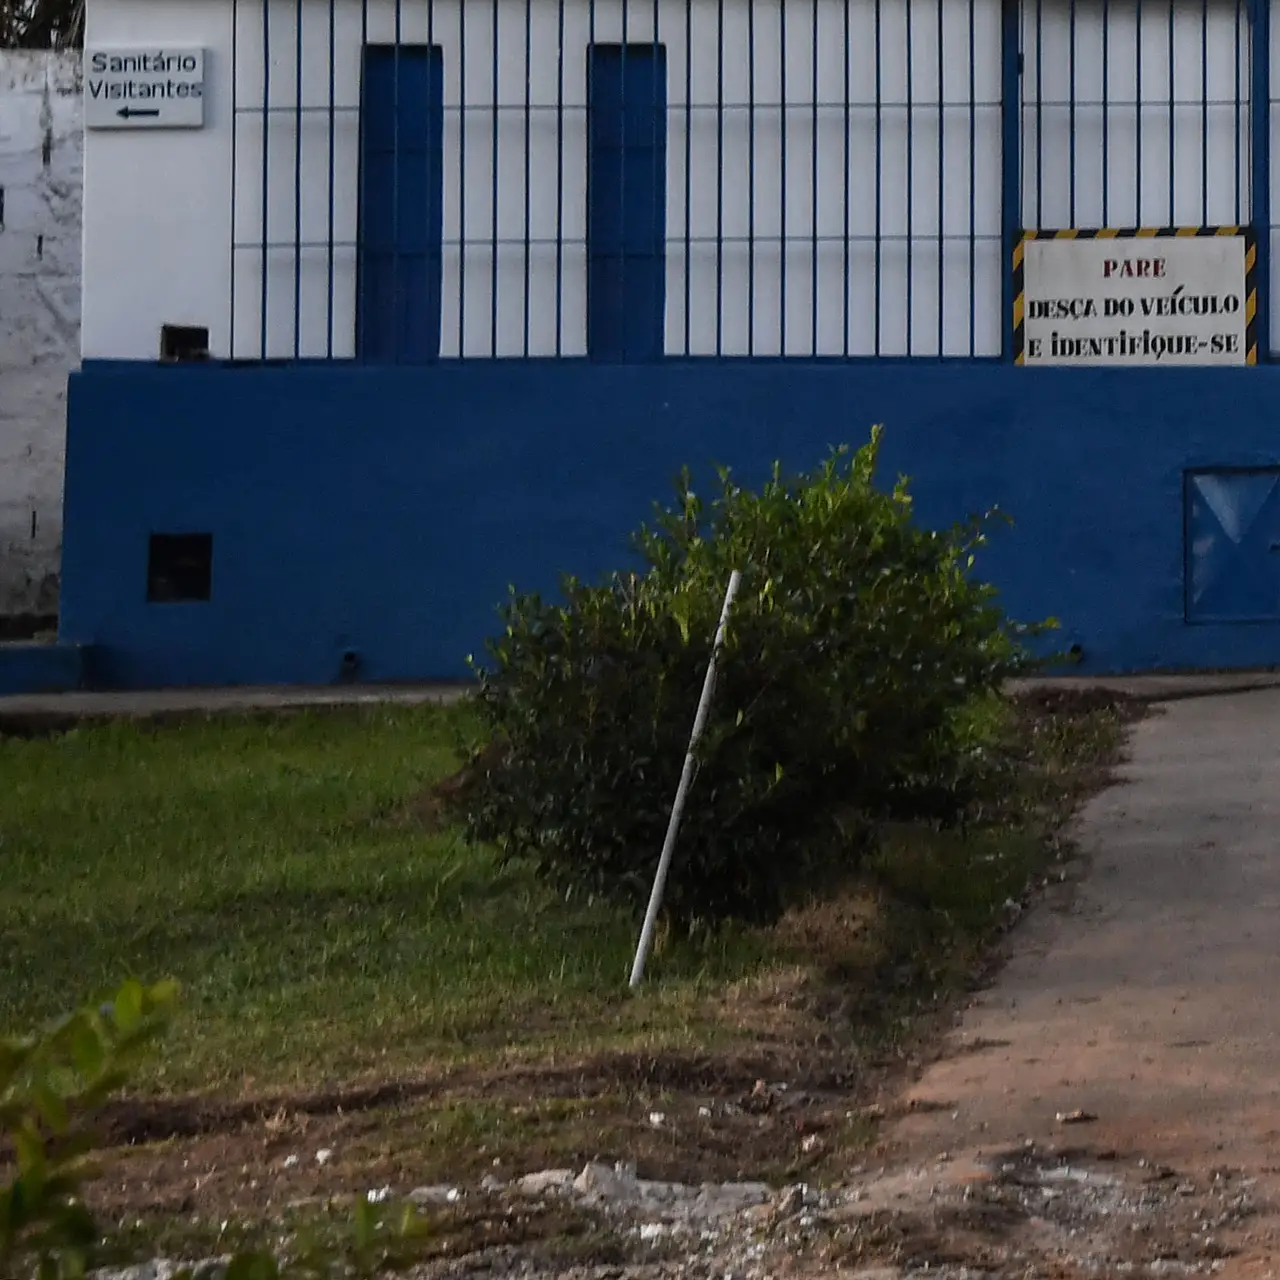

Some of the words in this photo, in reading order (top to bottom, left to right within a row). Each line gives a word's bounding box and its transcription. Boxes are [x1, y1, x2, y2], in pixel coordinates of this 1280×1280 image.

[91, 50, 196, 73] Sanitário
[89, 79, 202, 99] Visitantes
[1103, 259, 1166, 278] PARE
[1028, 298, 1098, 321] DESÇA
[1103, 297, 1135, 317] DO
[1140, 284, 1239, 317] VEÍCULO
[1027, 339, 1042, 358] E
